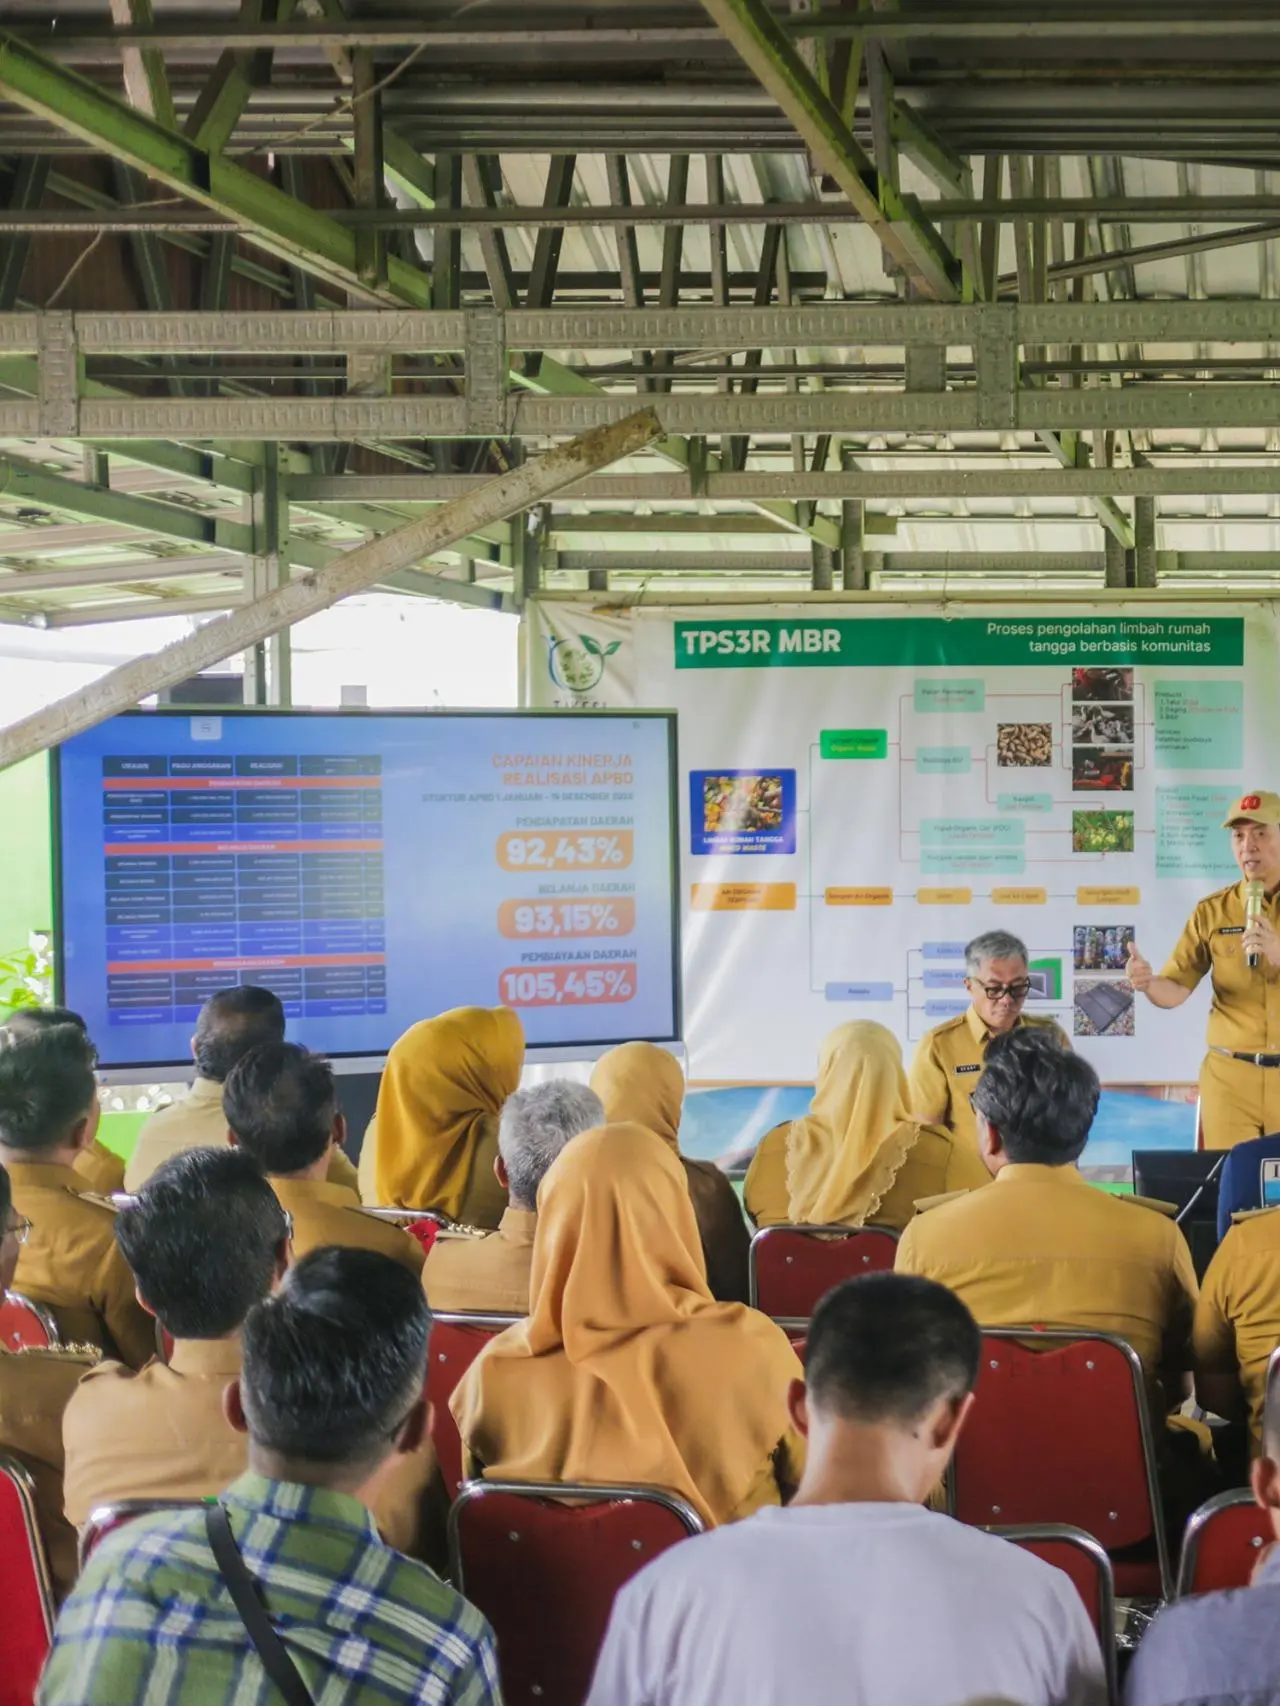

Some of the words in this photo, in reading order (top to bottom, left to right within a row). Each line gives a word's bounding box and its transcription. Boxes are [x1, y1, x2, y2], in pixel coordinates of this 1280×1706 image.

[987, 622, 1034, 636] Proses
[1037, 622, 1115, 637] pengolahan
[1119, 621, 1164, 635] limbah
[1168, 622, 1211, 635] rumah
[681, 630, 771, 655] TPS3R
[779, 628, 842, 653] MBR
[1029, 640, 1076, 655] tangga
[1080, 640, 1137, 653] berbasis
[1141, 639, 1211, 653] komunitas
[492, 753, 563, 769] CAPAIAN
[566, 754, 633, 769] KINERJA
[502, 772, 588, 786] REALISASI
[590, 771, 634, 785] APBD
[516, 817, 588, 827] PENDAPATAN
[590, 816, 634, 826] DAERAH
[506, 836, 624, 868] 92,43%
[514, 904, 619, 936] 93,15%
[521, 950, 591, 962] PEMBIAYAAN
[593, 949, 637, 960] DAERAH
[504, 969, 632, 1002] 105,45%
